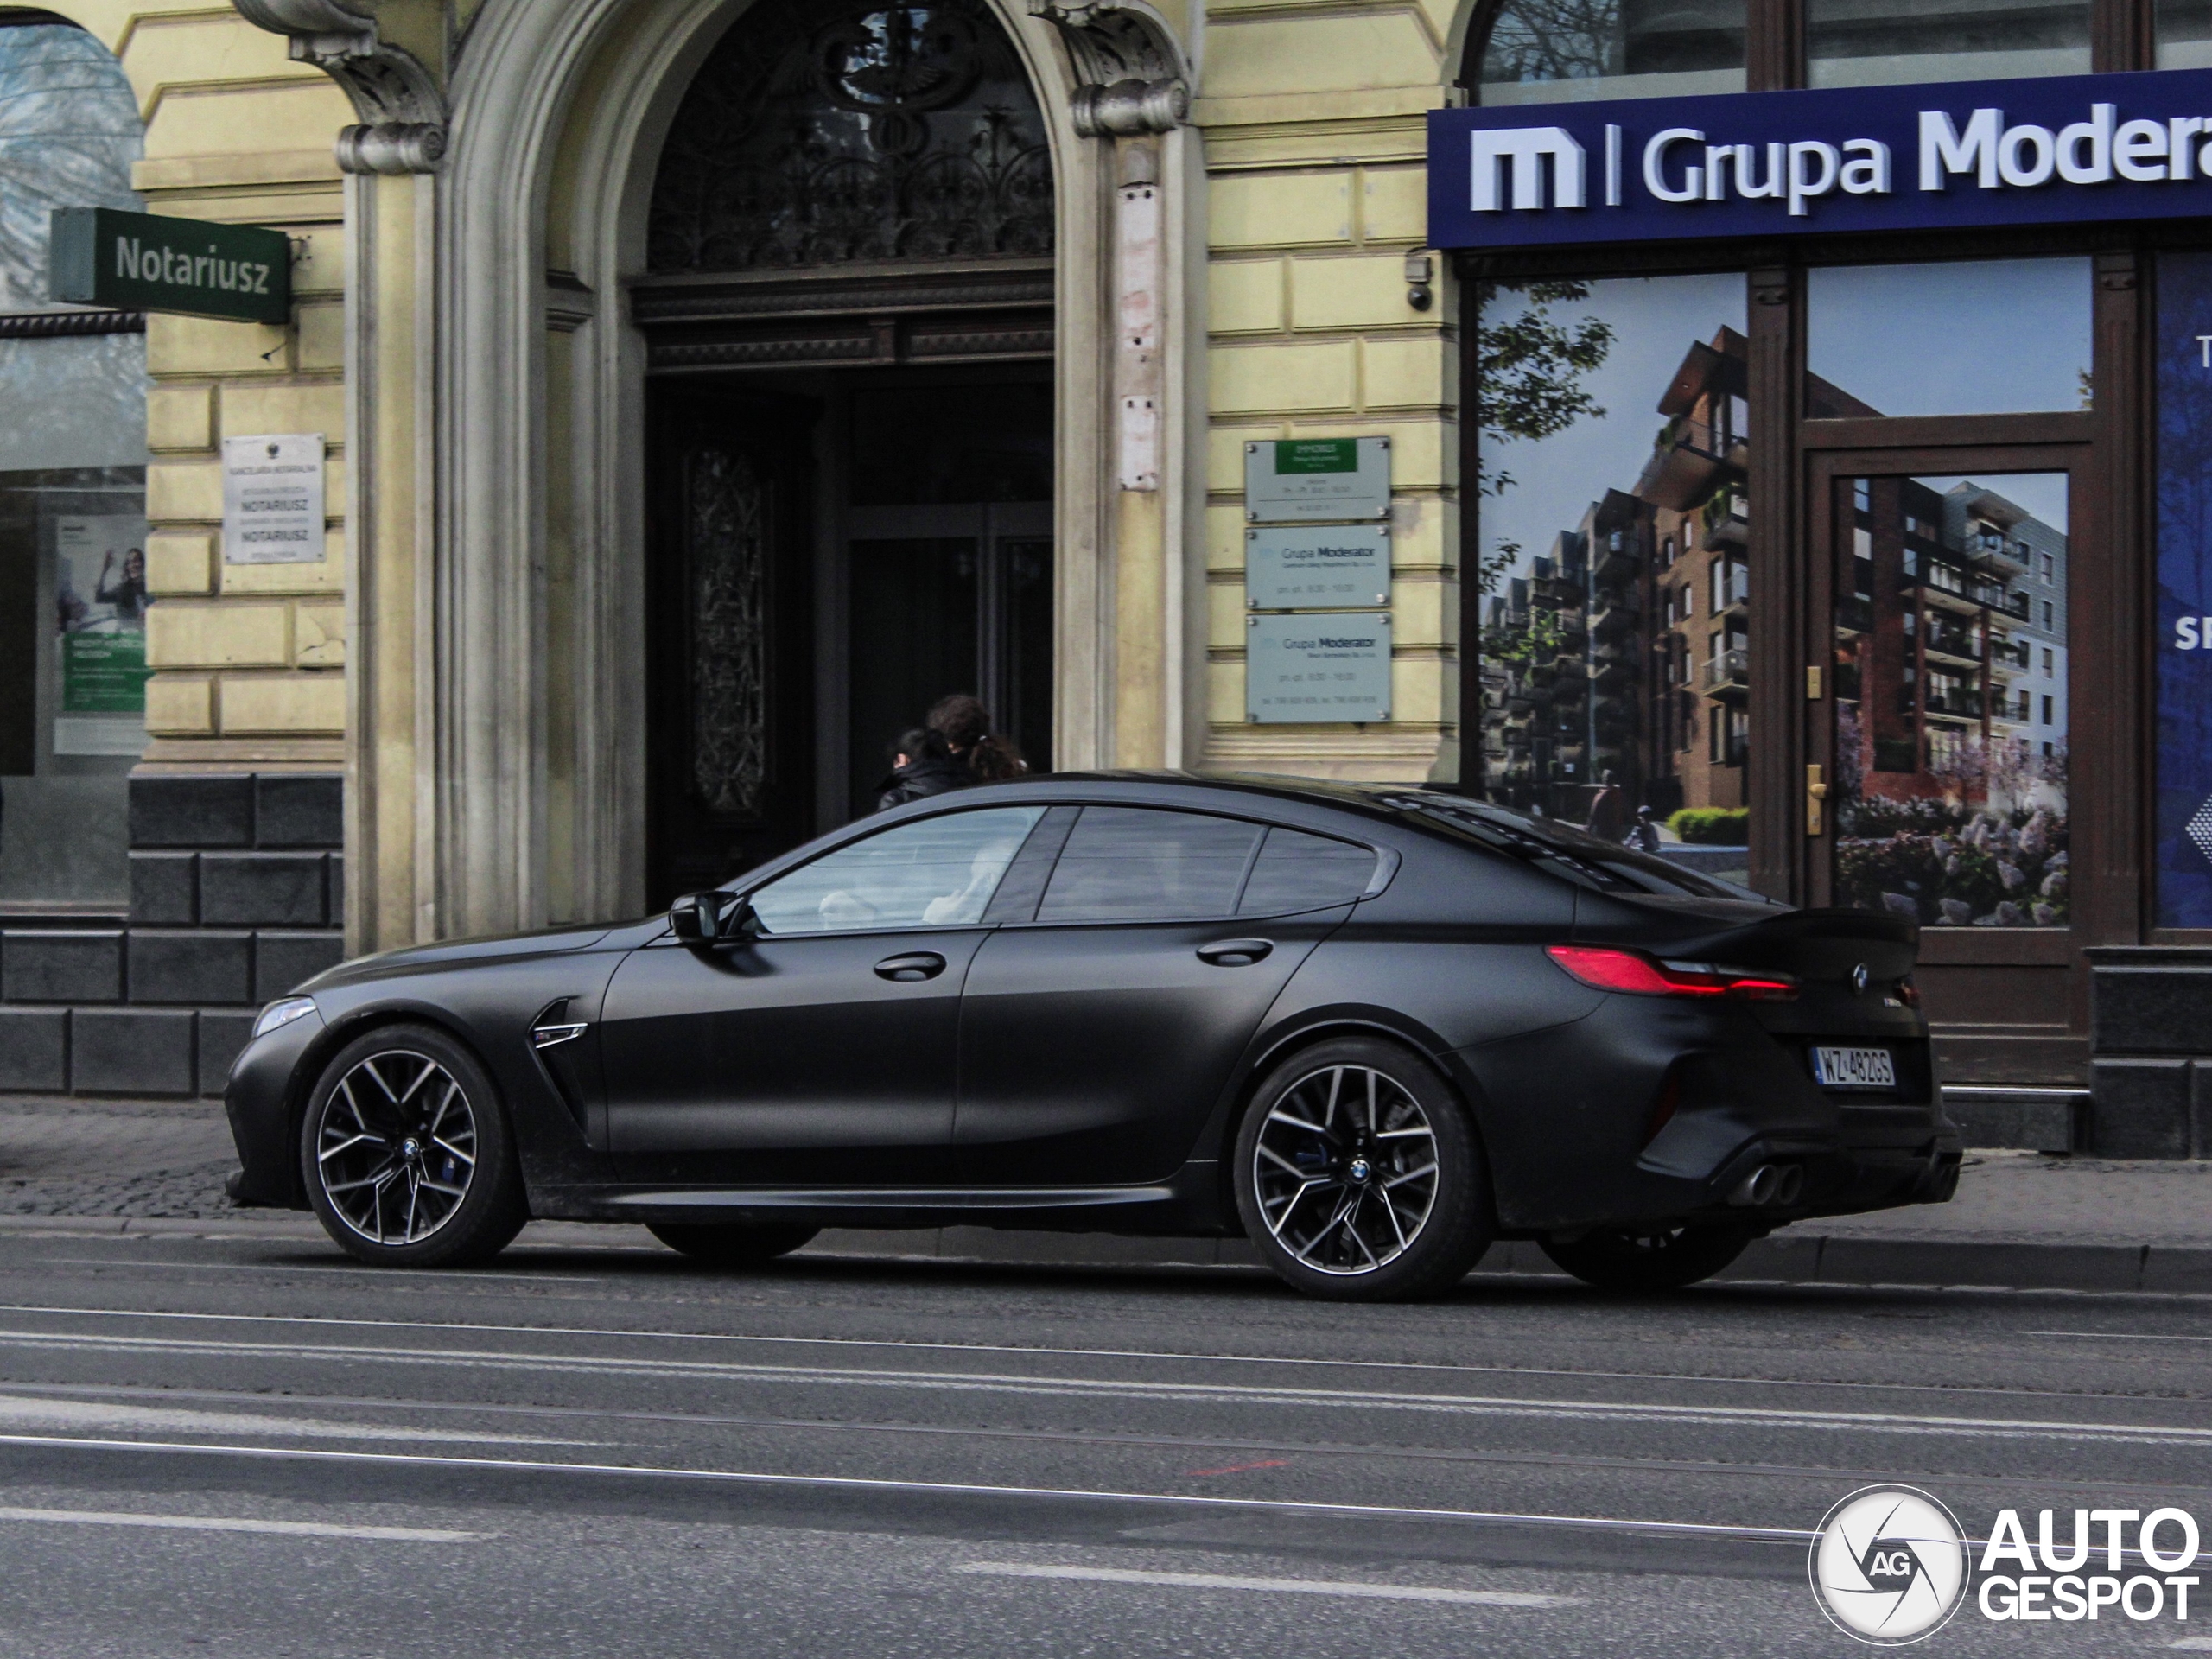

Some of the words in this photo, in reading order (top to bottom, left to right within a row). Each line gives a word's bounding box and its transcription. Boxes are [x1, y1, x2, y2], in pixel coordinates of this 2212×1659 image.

[1643, 127, 1892, 217] Grupa
[116, 236, 270, 295] Notariusz
[241, 499, 309, 512] NOTARIUSZ
[241, 529, 309, 543] NOTARIUSZ
[1281, 548, 1315, 561] Grupa
[1317, 547, 1376, 558] Moderator
[1282, 638, 1316, 650] Grupa
[1319, 637, 1376, 648] Moderator
